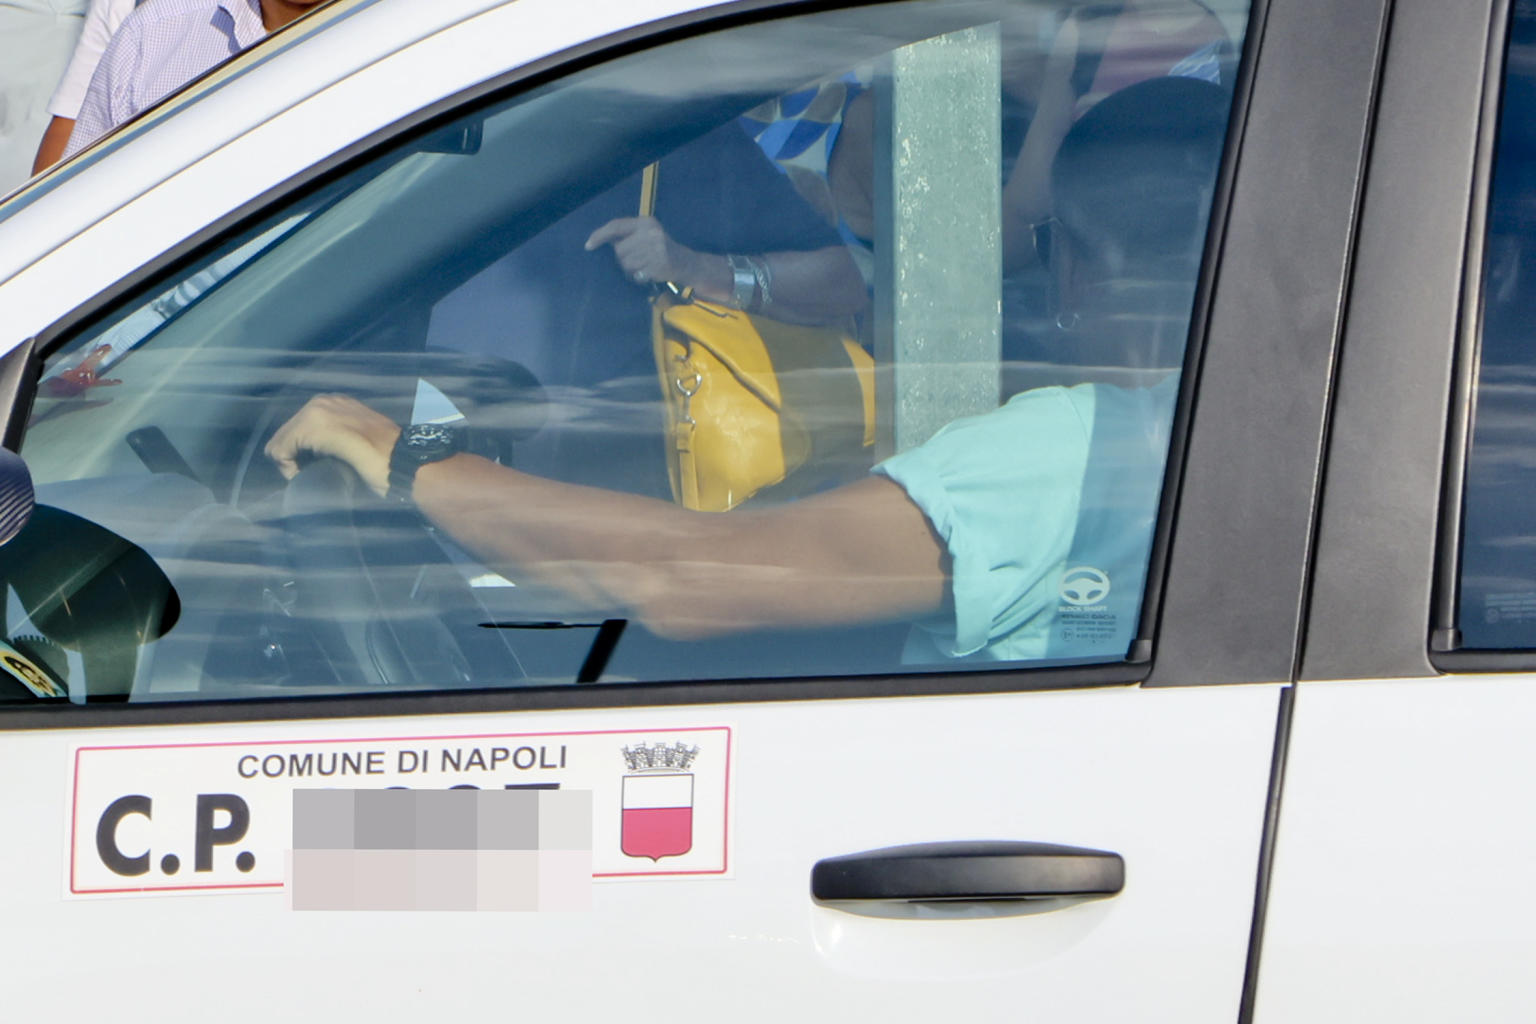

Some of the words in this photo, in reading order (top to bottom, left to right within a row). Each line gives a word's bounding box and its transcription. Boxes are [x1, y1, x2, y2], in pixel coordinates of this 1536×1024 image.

[237, 751, 386, 779] COMUNE
[397, 749, 429, 773] DI
[441, 745, 567, 773] NAPOLI
[95, 792, 257, 877] C.P.
